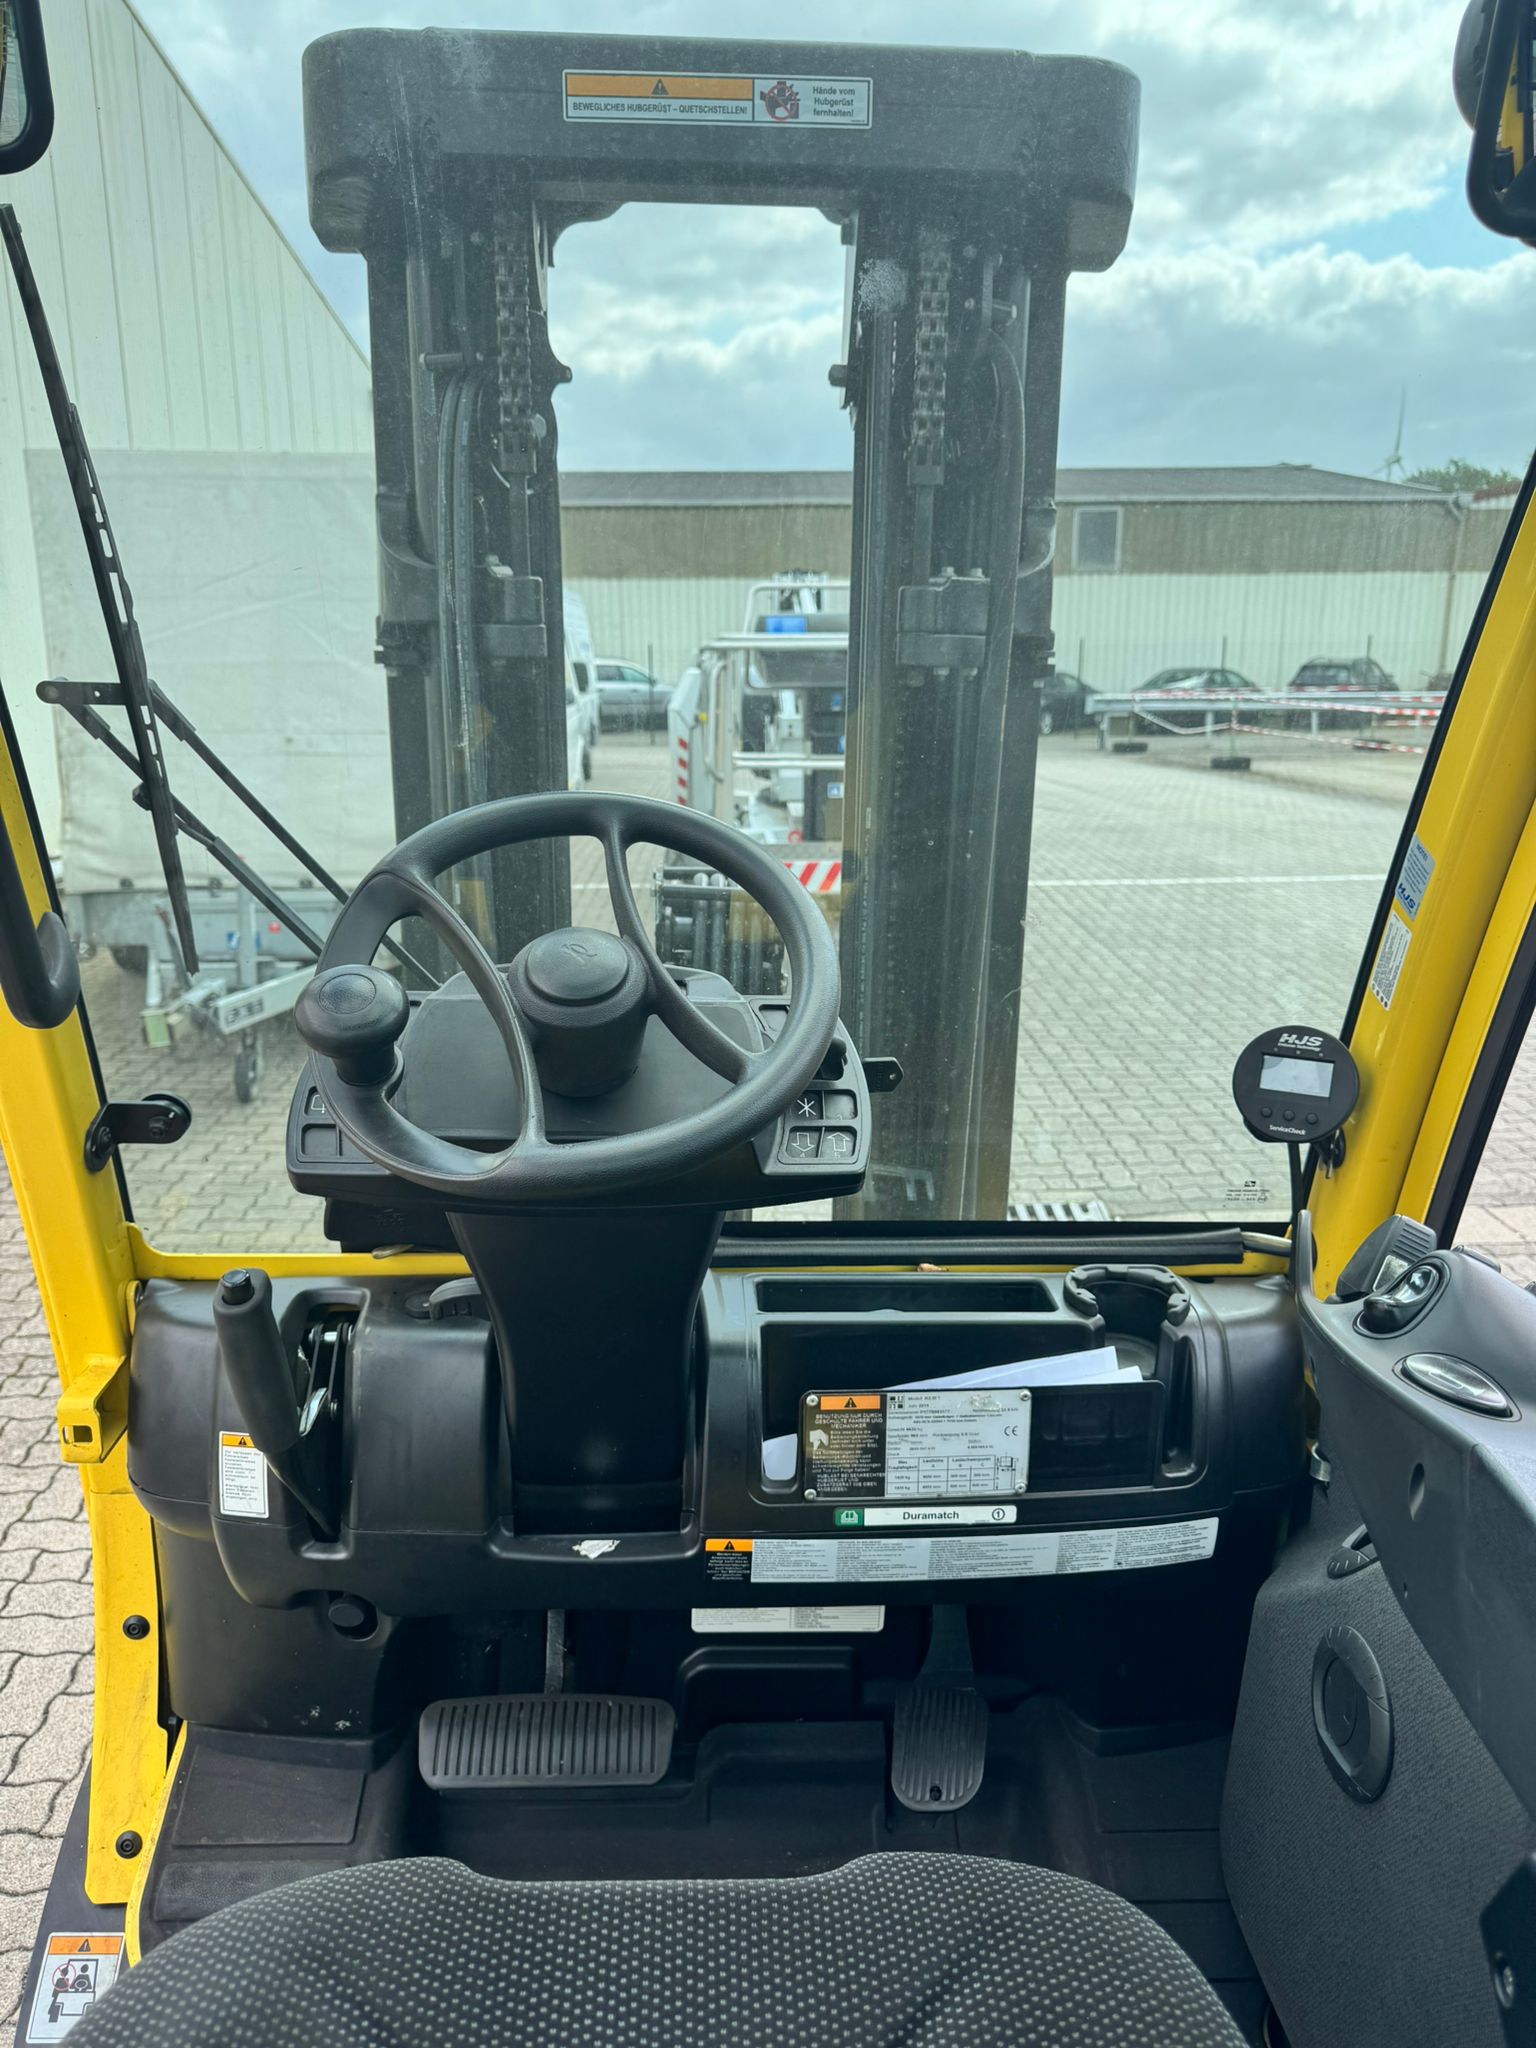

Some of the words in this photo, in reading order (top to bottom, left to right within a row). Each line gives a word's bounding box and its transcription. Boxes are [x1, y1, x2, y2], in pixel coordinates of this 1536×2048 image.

[812, 86, 837, 95] Hände
[814, 97, 854, 108] Hubgerüst
[573, 102, 625, 112] BEWEGLICHES
[627, 102, 671, 113] HUBGERÜST
[679, 104, 748, 115] QUETSCHSTELLEN!
[813, 108, 854, 117] fernhalten!
[1279, 1033, 1323, 1047] HJS
[902, 1510, 960, 1520] Duramatch
